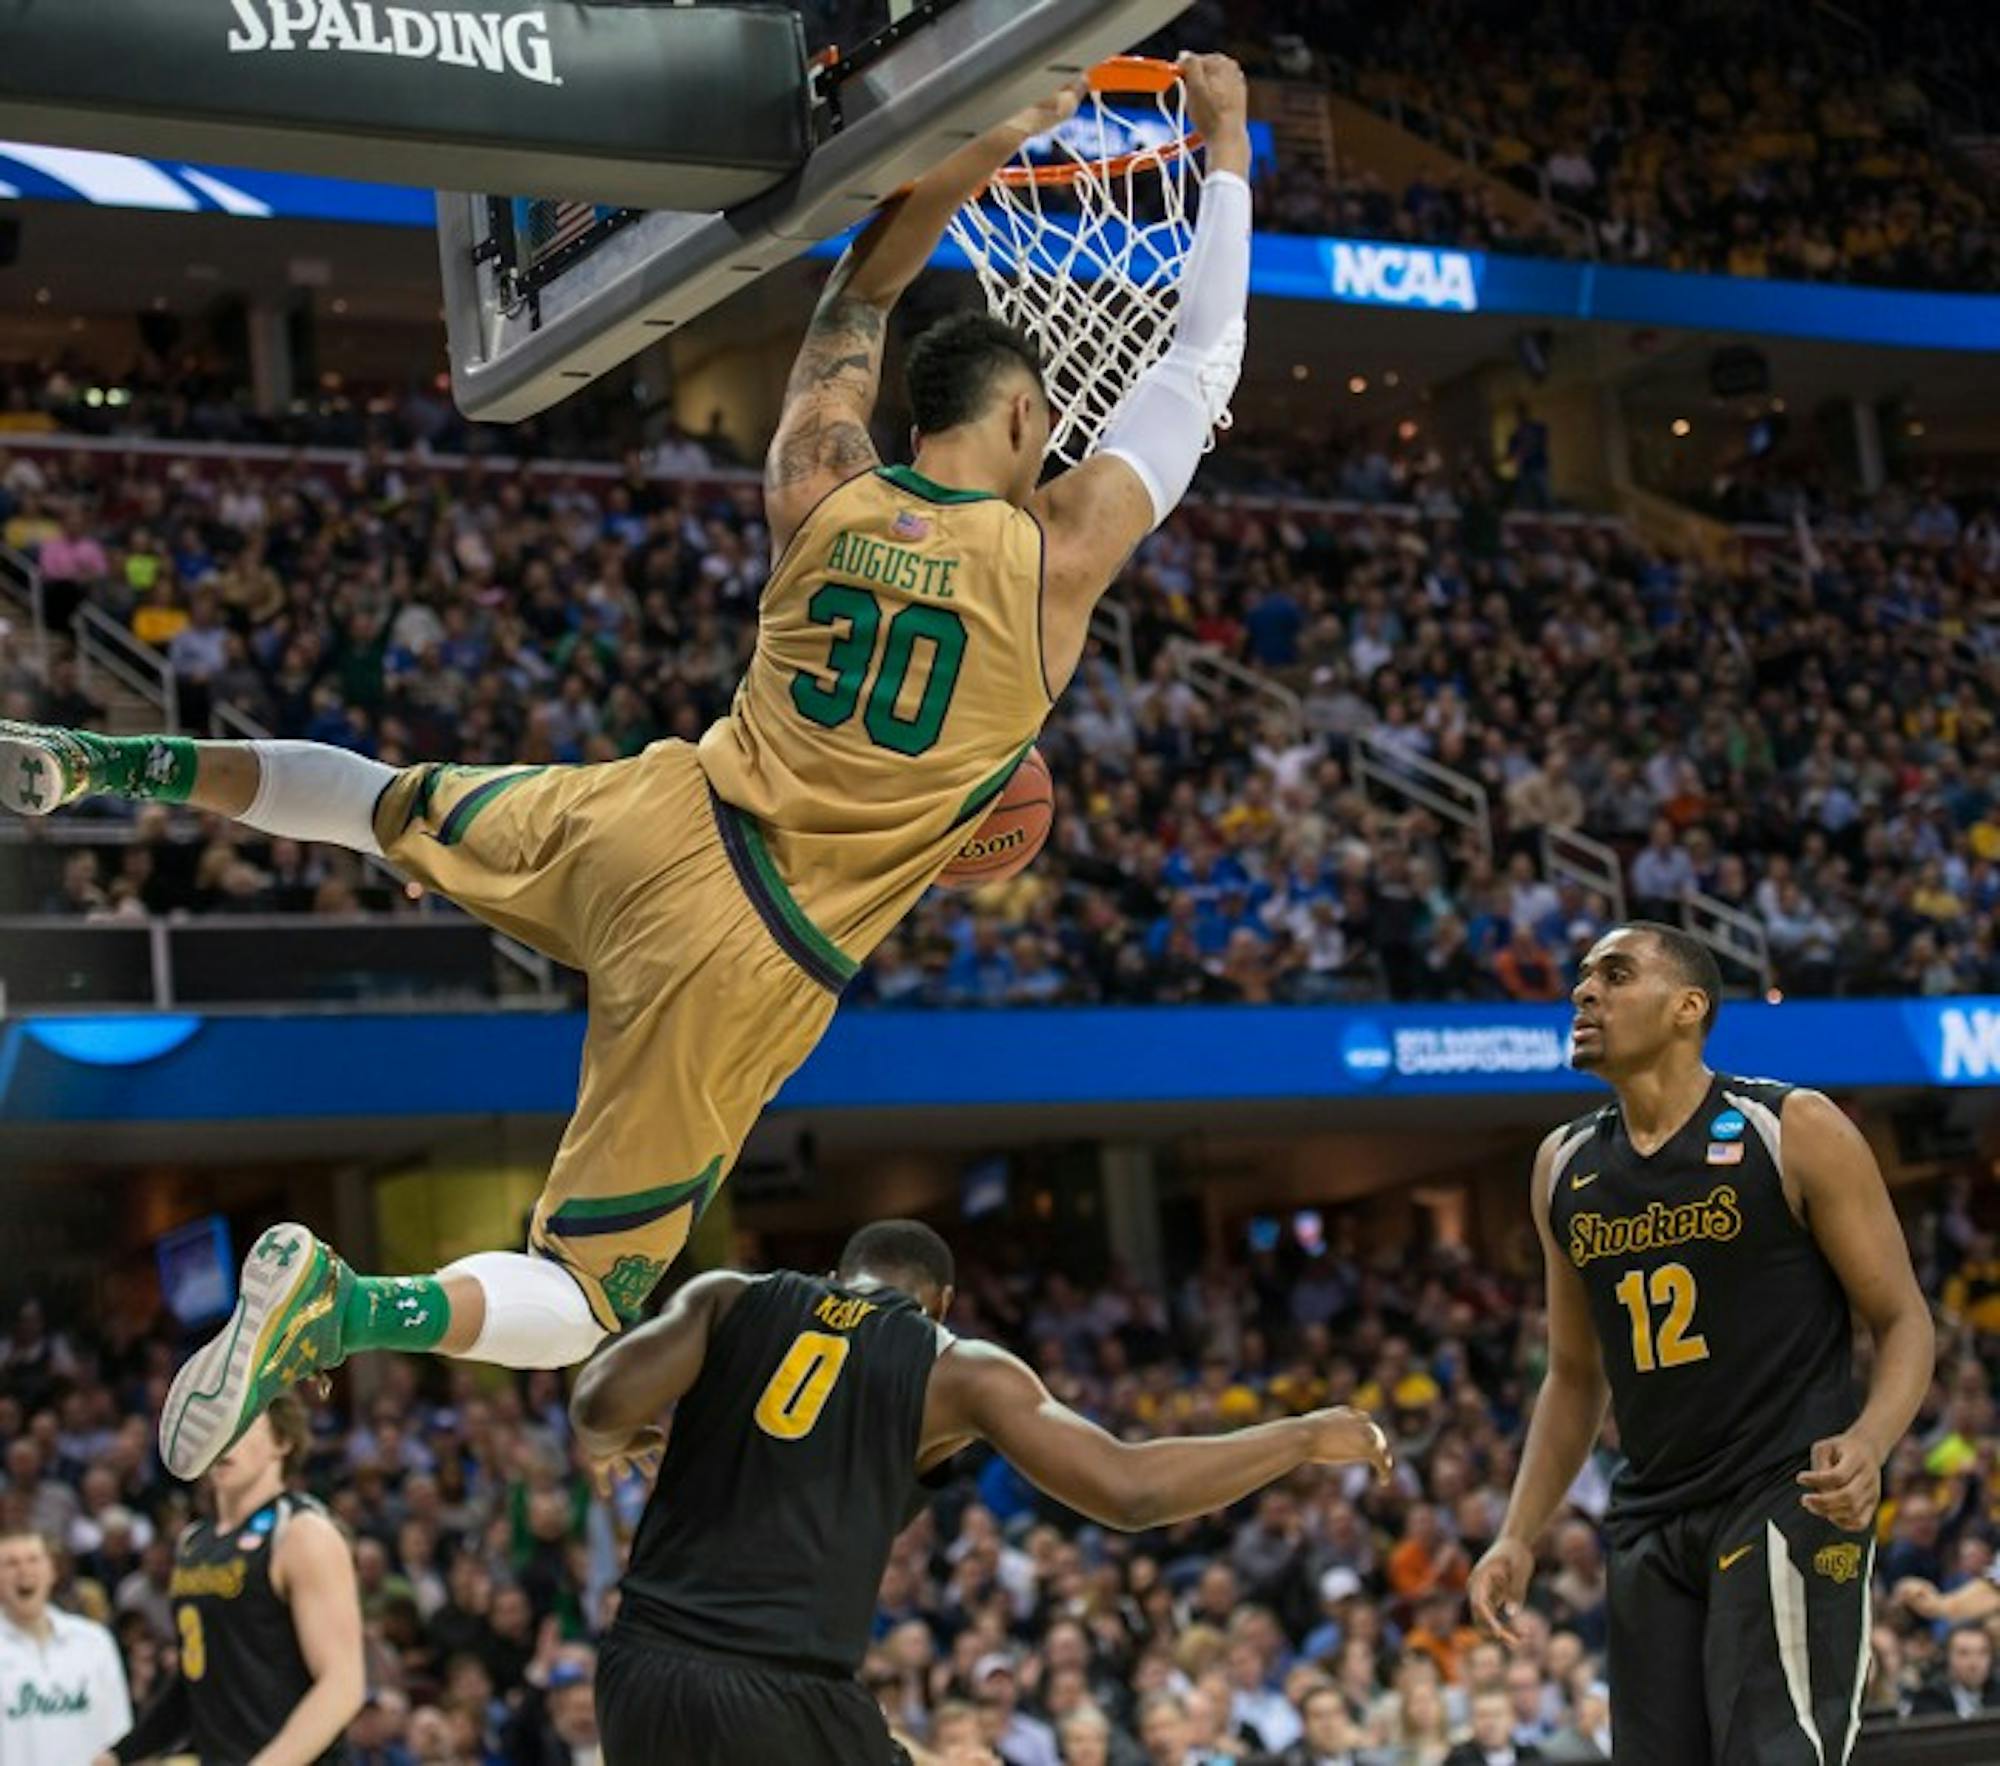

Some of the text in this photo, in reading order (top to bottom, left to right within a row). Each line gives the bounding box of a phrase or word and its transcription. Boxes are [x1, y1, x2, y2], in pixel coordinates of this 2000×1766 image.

[228, 0, 556, 84] SPALDING
[1332, 243, 1478, 312] NCAA
[828, 531, 959, 598] AUGUSTE
[789, 581, 968, 757] 30
[1616, 1262, 1711, 1373] 12
[754, 1330, 849, 1438] 0
